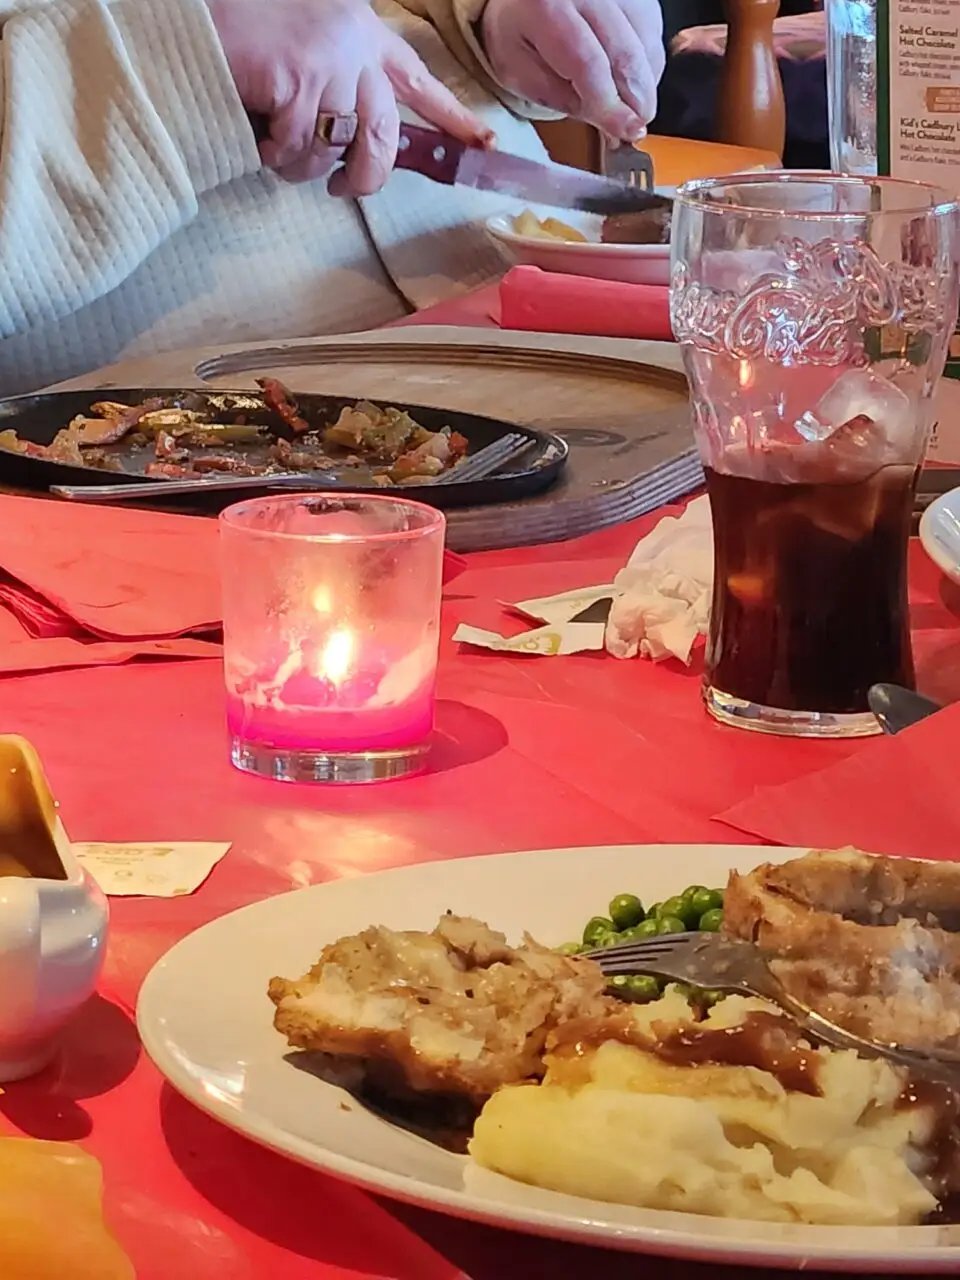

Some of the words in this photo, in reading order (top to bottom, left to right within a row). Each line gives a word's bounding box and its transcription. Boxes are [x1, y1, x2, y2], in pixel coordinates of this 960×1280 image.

[899, 24, 923, 36] Salted
[925, 26, 958, 38] Caramel
[899, 36, 915, 47] Hot
[916, 37, 956, 50] Chocolate
[921, 119, 954, 134] Cadbury
[900, 128, 915, 139] Hot
[917, 130, 956, 142] Chocolate
